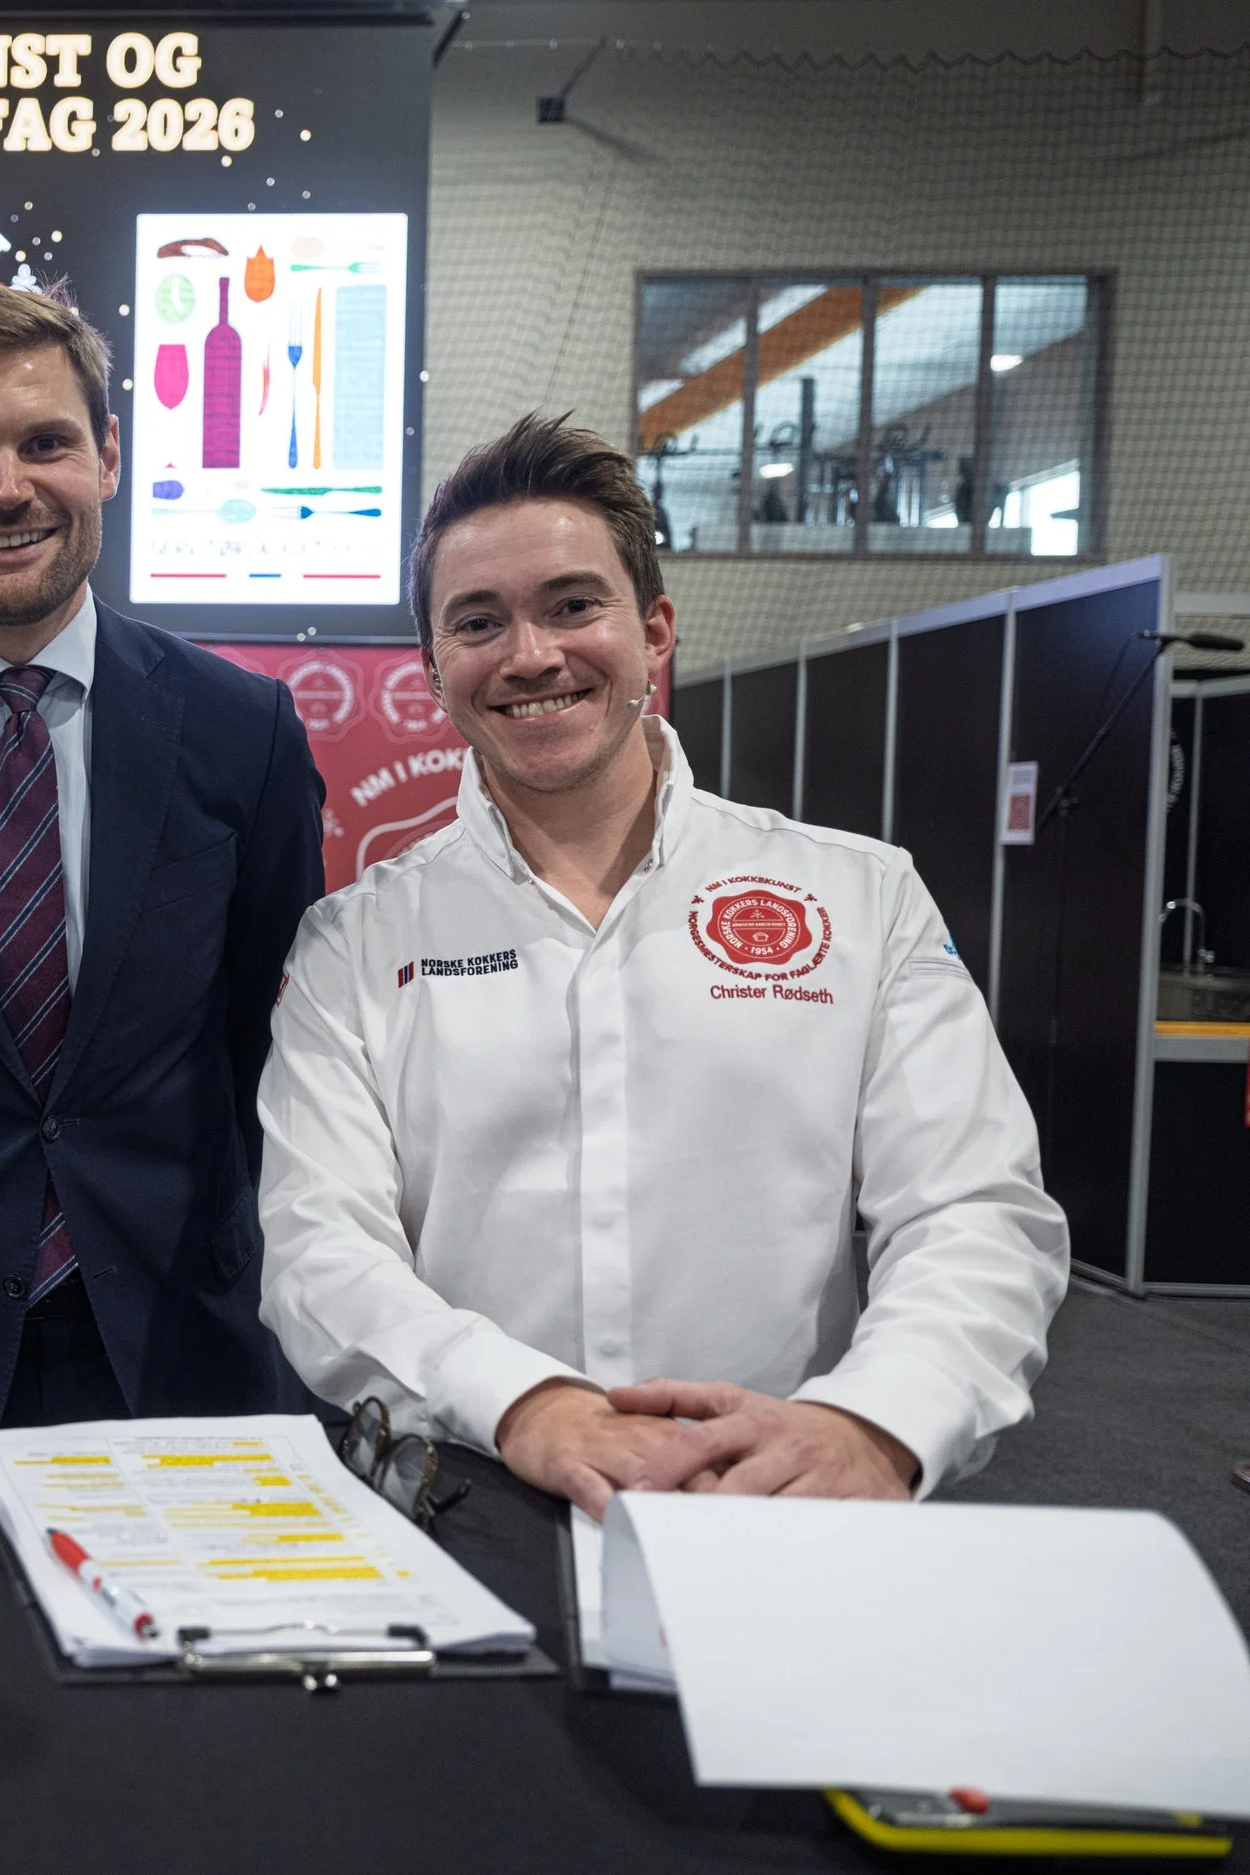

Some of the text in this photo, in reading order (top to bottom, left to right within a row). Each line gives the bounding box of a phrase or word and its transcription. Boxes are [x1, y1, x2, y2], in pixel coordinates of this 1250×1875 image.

[106, 33, 202, 89] OG
[112, 98, 255, 152] 2026
[351, 766, 395, 807] NM
[394, 761, 408, 783] I
[705, 881, 722, 893] NM
[727, 876, 802, 893] KOKKEKUNST
[721, 899, 797, 949] NORSKE KOKKERS LANDSFORENING
[421, 949, 516, 968] NORSKE KOKKERS
[688, 906, 832, 981] NORGESMESTERSKAP FOR FAGLÆRTE KOKKER
[750, 946, 773, 955] 1954
[422, 959, 518, 976] LANDSFORENING
[710, 984, 833, 1004] Christer Rødseth
